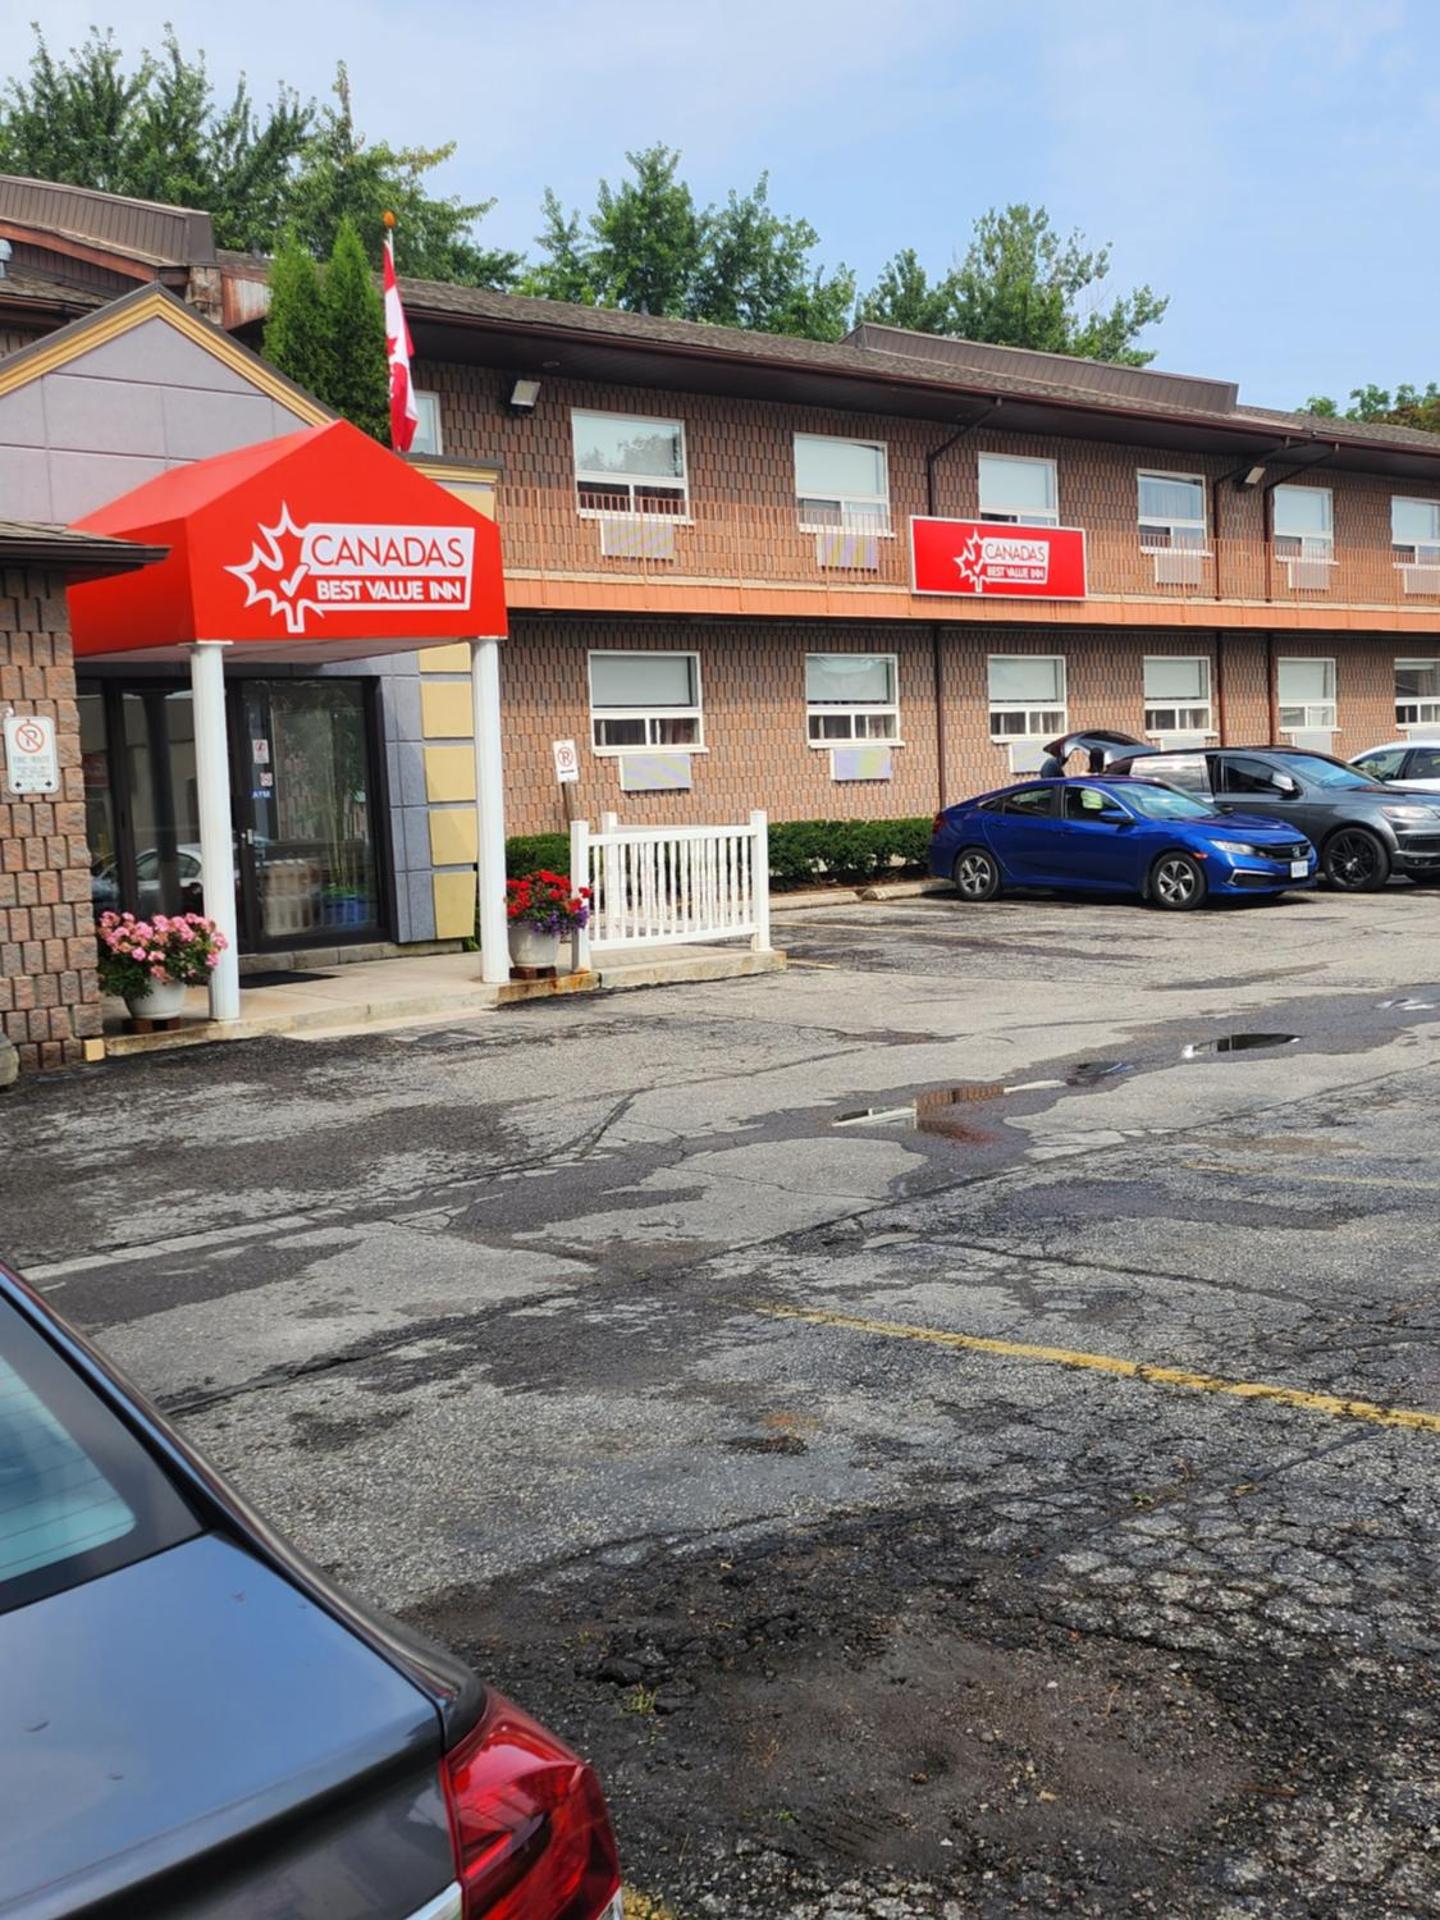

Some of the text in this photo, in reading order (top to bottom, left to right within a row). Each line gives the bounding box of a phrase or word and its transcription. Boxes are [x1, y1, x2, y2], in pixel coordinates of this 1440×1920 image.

[310, 534, 465, 568] CANADAS
[984, 543, 1046, 562] CANADAS
[986, 566, 1045, 579] BEST VALUE INN
[317, 579, 461, 600] BEST VALUE INN
[252, 790, 271, 799] ATM
